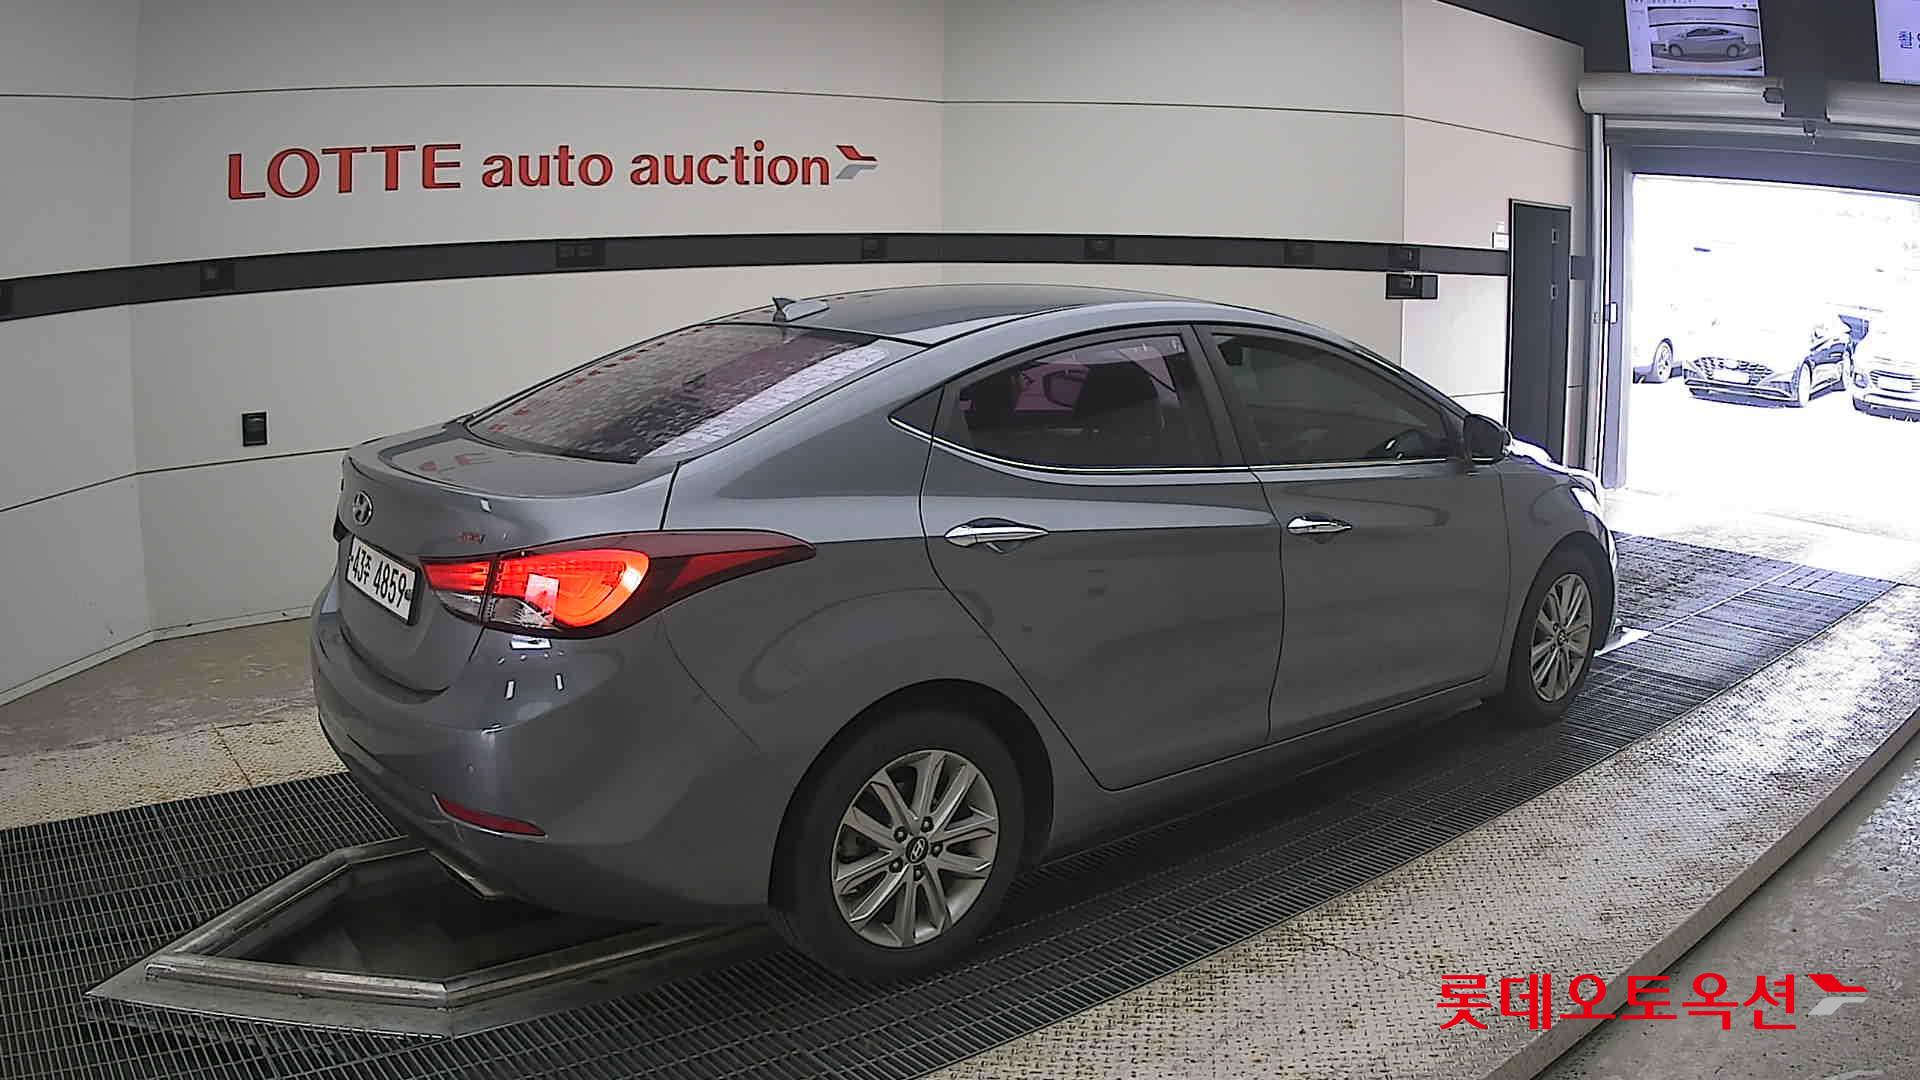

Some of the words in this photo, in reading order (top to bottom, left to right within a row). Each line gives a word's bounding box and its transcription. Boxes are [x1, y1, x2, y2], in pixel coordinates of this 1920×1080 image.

[229, 144, 462, 199] LOTTE
[483, 145, 613, 187] auto
[630, 140, 830, 185] auction
[373, 560, 407, 608] 4859
